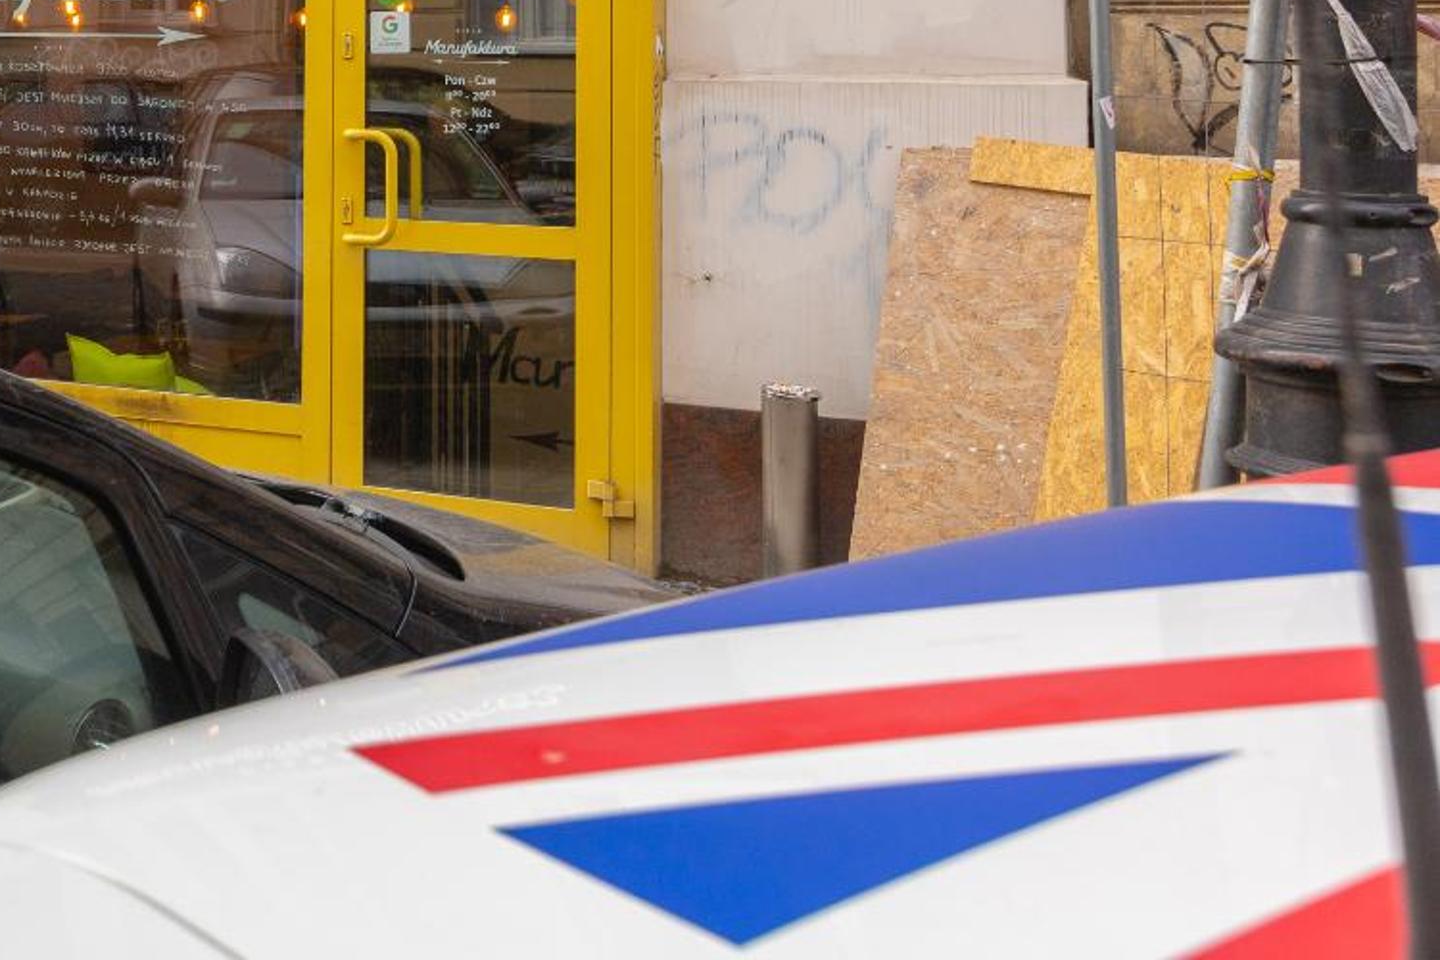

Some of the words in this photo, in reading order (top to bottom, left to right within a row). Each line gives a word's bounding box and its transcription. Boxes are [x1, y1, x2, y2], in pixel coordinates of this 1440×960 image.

[423, 38, 519, 59] Manufaktura
[444, 74, 465, 86] Pon
[15, 90, 45, 103] JEST
[450, 106, 464, 118] Pt
